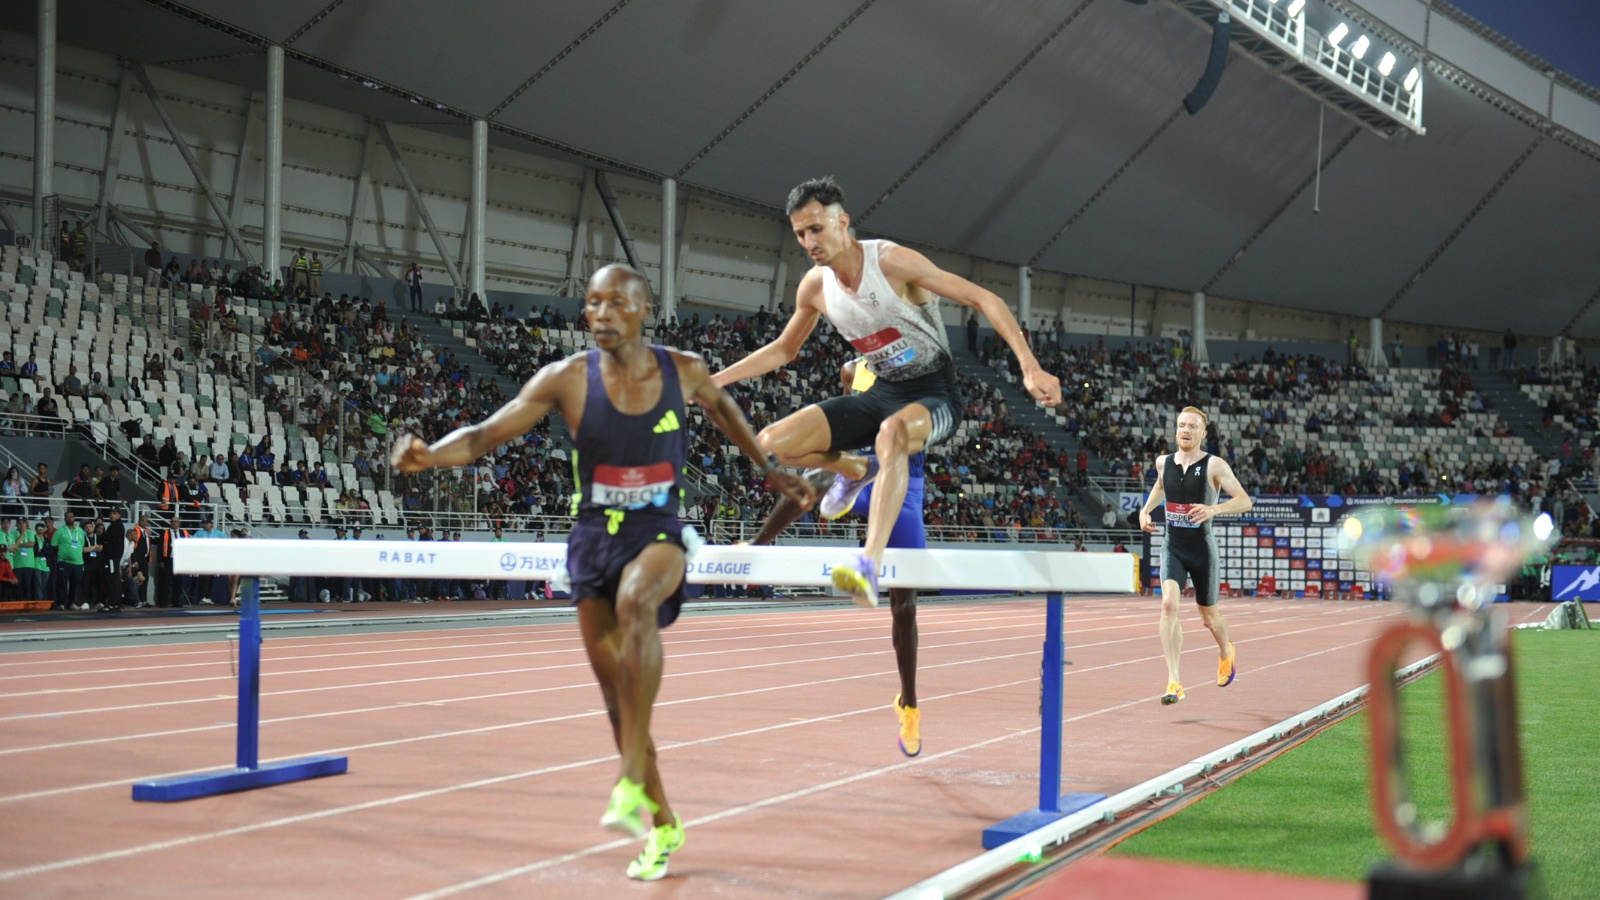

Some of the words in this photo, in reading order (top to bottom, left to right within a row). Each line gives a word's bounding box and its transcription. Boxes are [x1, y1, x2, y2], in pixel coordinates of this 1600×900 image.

[1167, 512, 1194, 522] RUPPER
[379, 551, 436, 563] RABAT
[698, 562, 752, 575] LEAGUE
